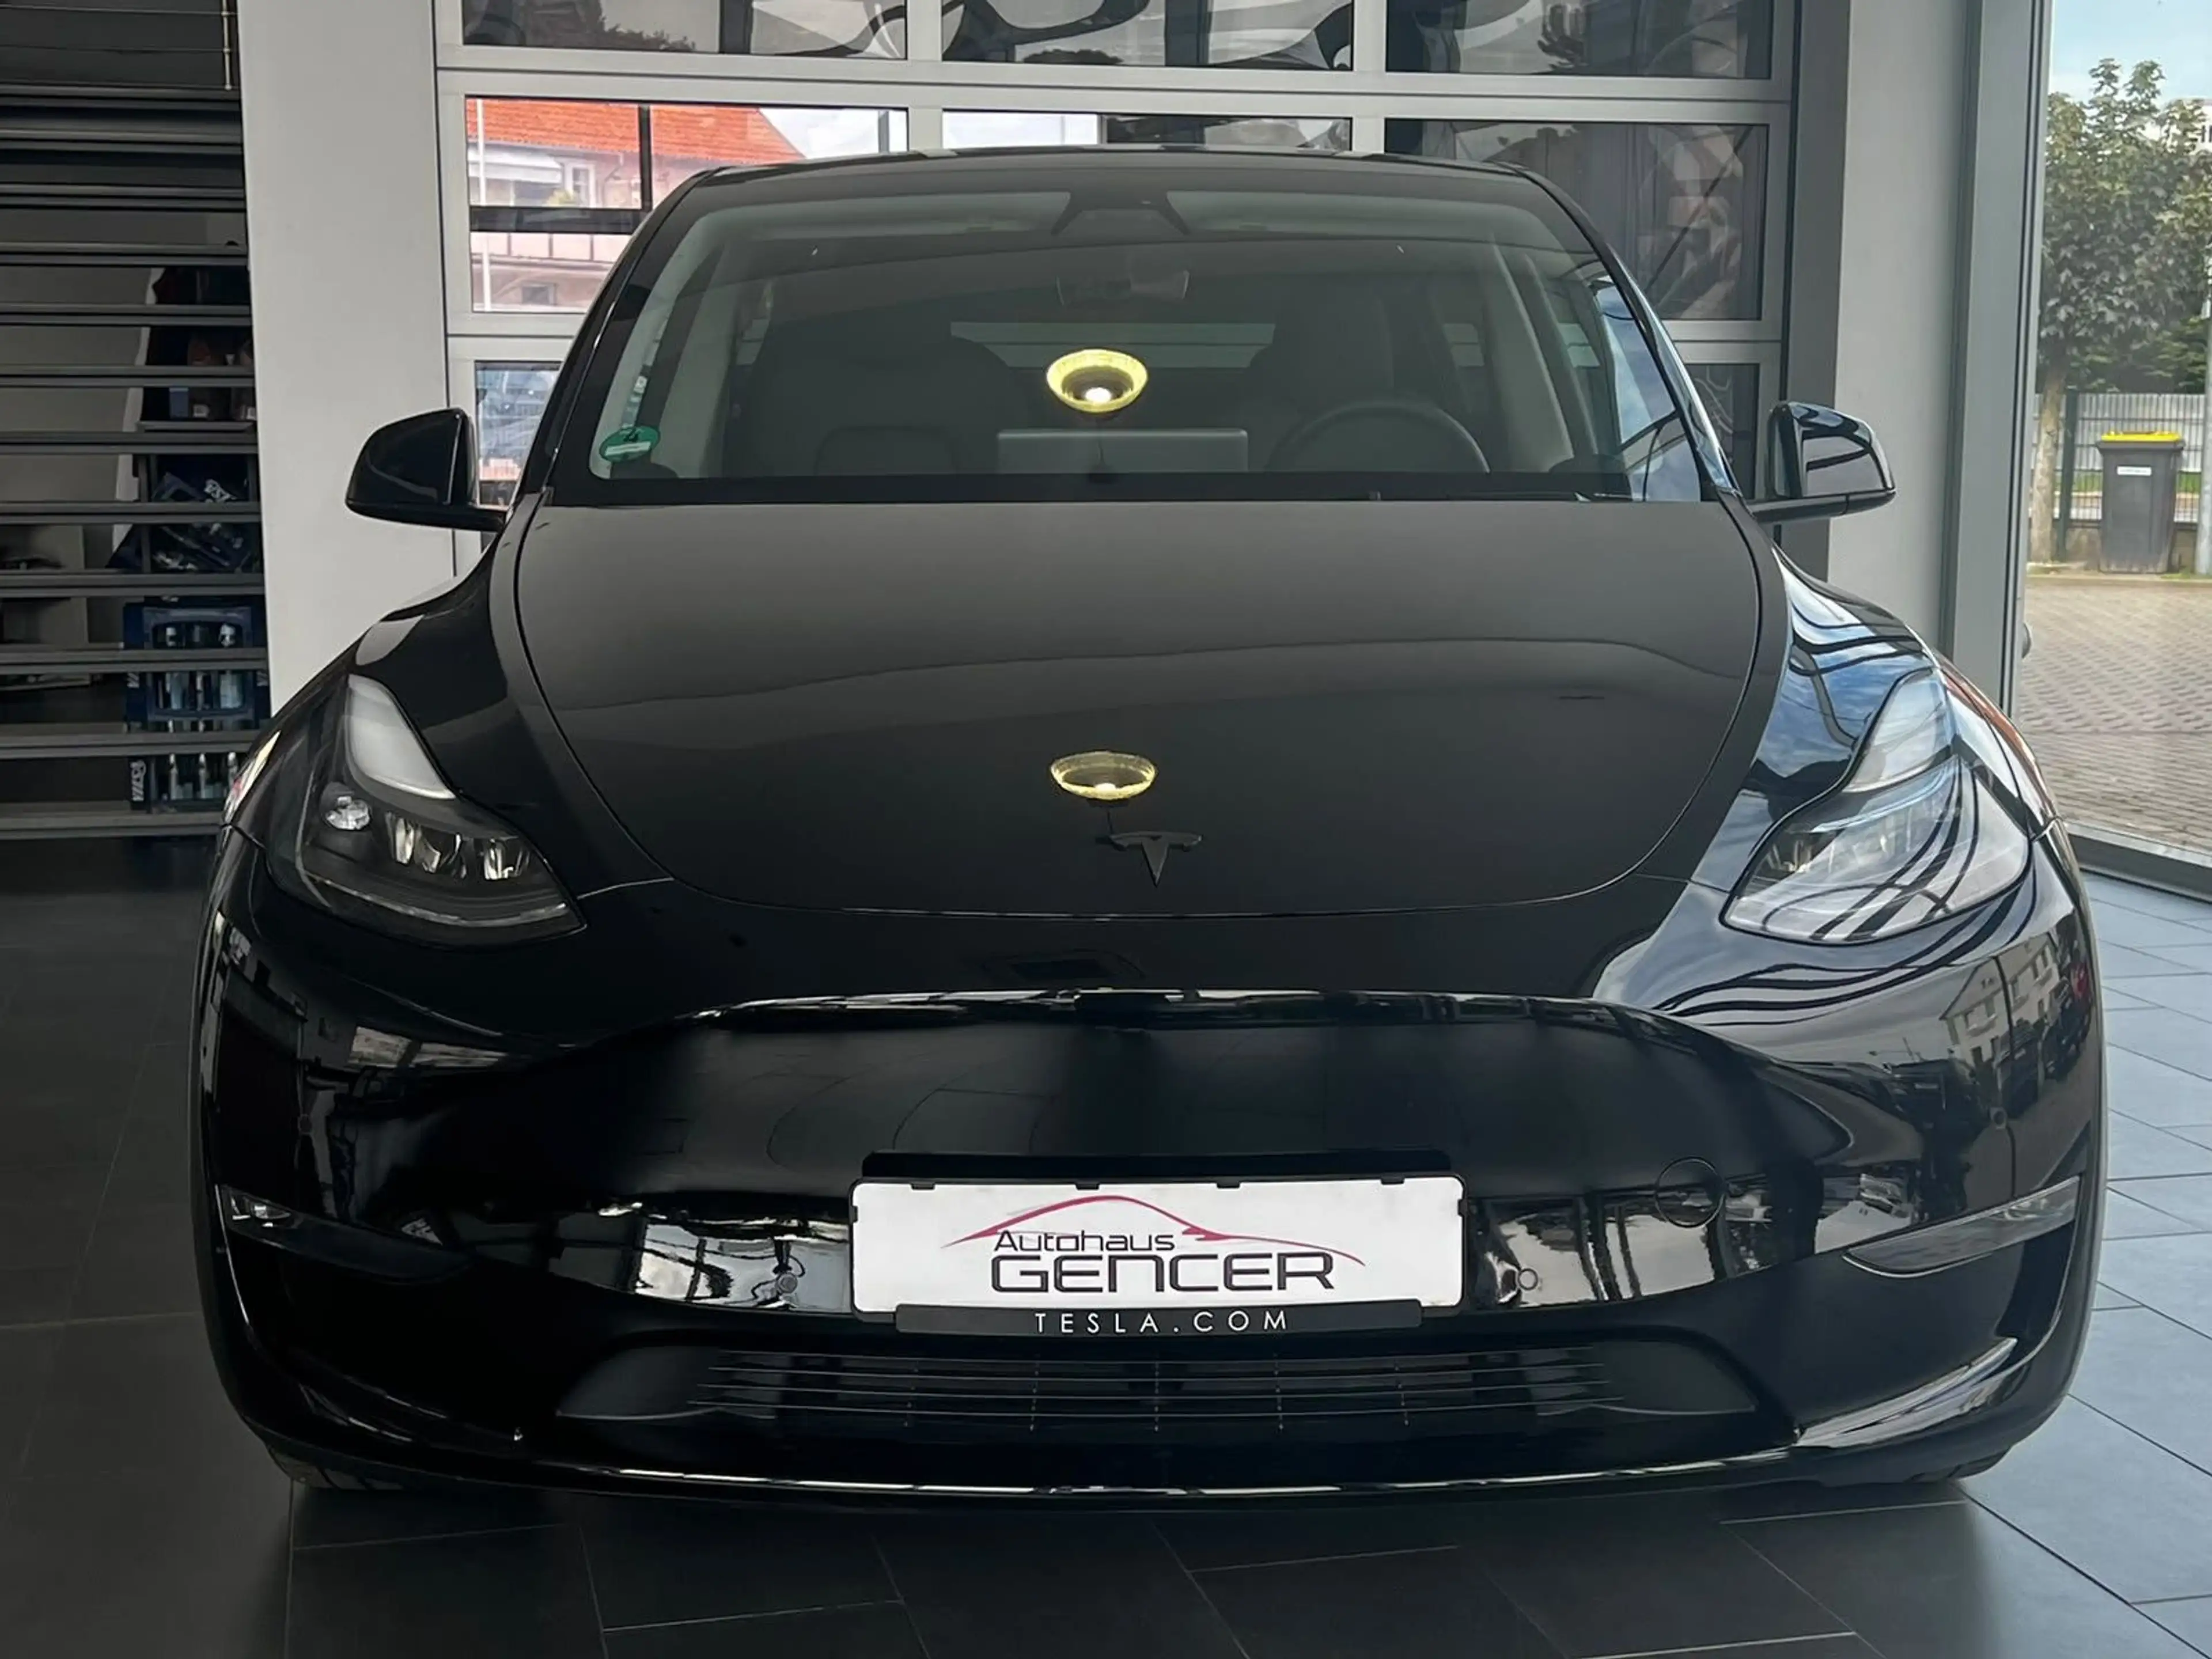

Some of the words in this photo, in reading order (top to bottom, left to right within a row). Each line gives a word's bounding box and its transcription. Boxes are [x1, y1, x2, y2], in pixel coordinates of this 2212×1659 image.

[994, 1230, 1176, 1252] Autohaus
[991, 1252, 1334, 1292] GENCER
[1035, 1309, 1287, 1334] TESLA.COM
